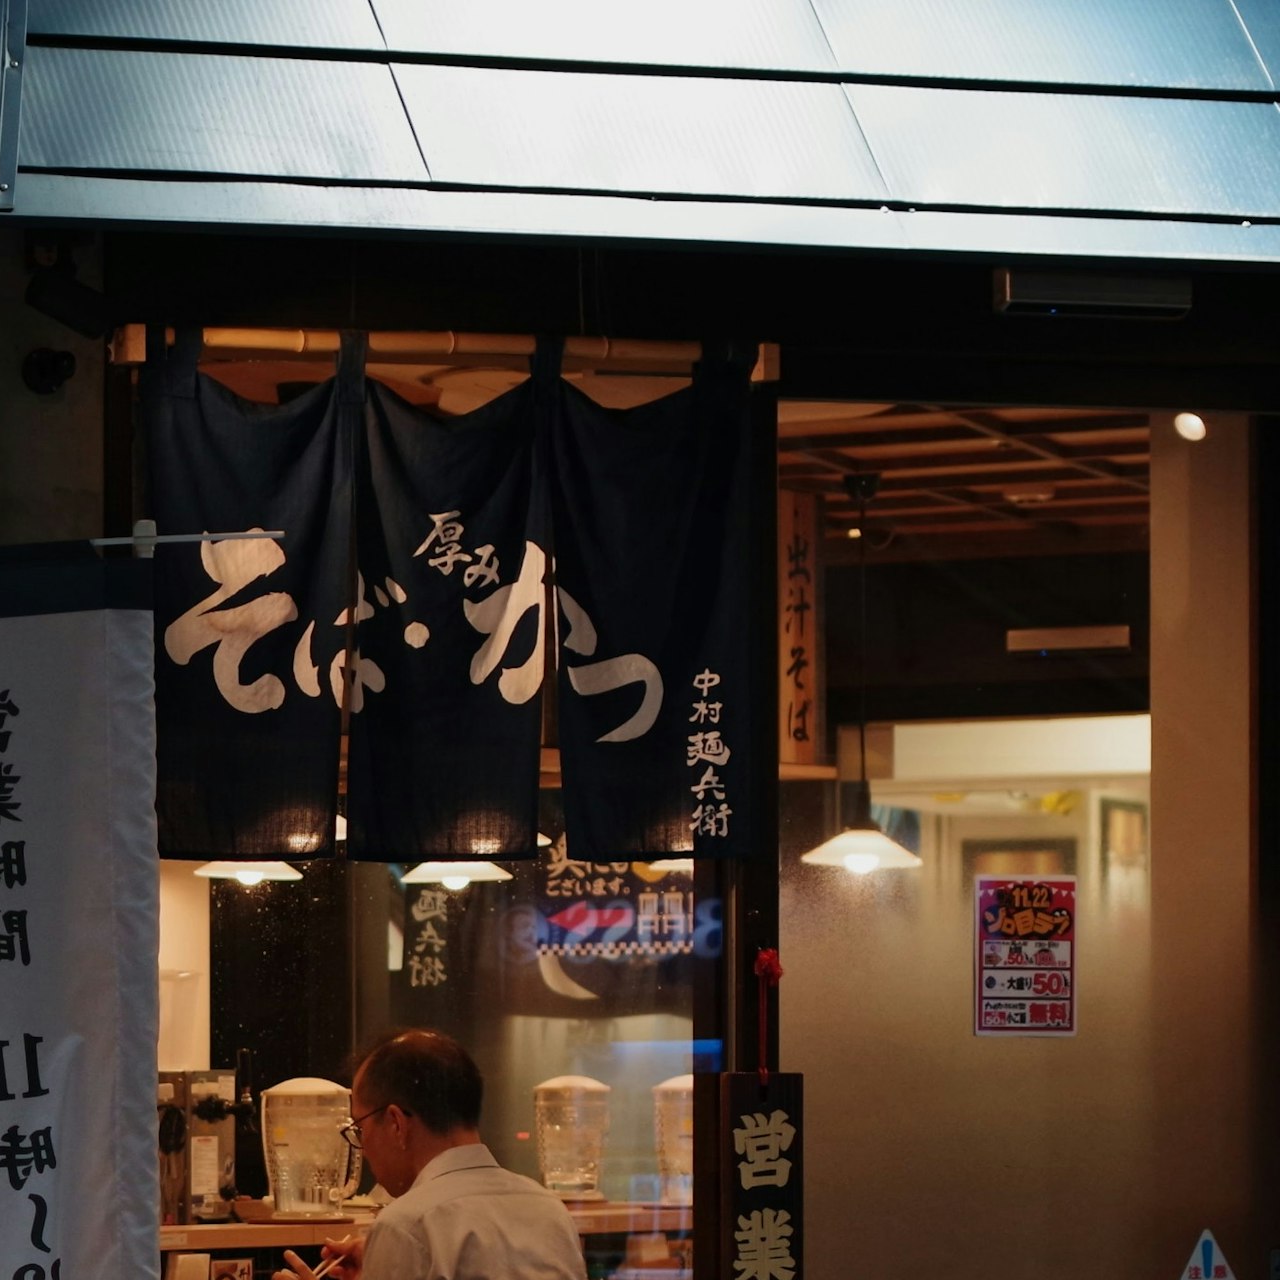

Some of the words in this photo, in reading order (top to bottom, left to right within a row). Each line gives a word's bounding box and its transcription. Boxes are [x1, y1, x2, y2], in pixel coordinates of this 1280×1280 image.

[413, 509, 502, 588] 厚み
[546, 877, 631, 897] ございます。
